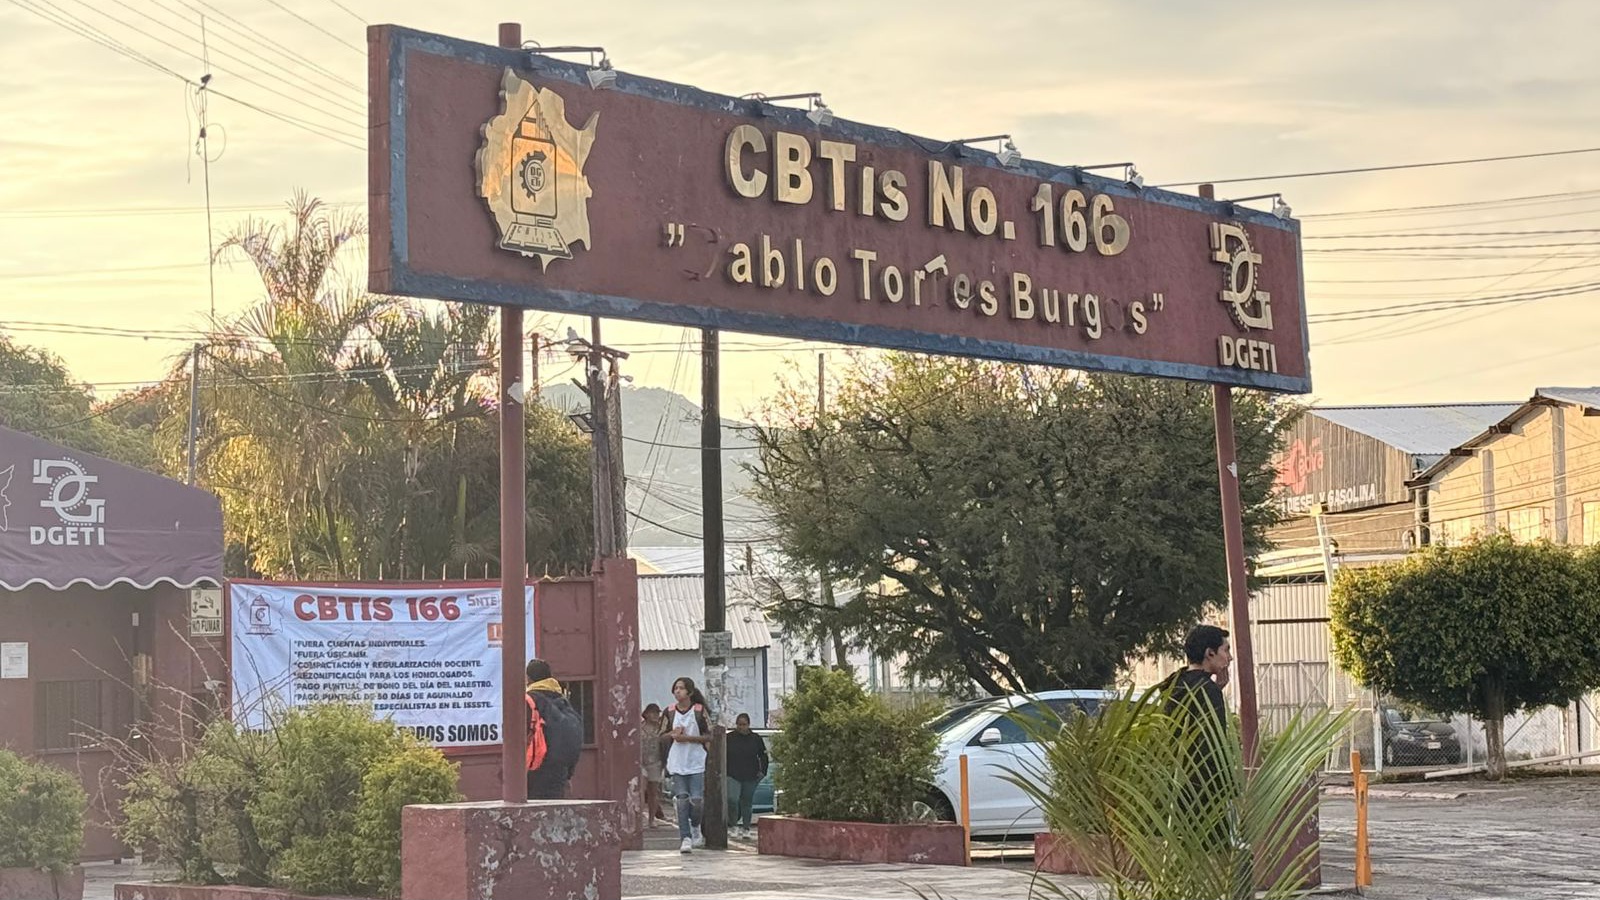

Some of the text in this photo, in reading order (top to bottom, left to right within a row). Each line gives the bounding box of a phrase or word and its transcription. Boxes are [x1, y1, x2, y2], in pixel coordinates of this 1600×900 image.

[724, 124, 1130, 257] CBTis No. 166
[1218, 335, 1278, 374] DGETI
[1328, 483, 1376, 507] GASOLINA
[30, 526, 105, 546] DGETI
[293, 594, 461, 621] CBTIS 166
[201, 619, 221, 633] FUMAR
[327, 640, 366, 648] CUENTAS
[372, 659, 442, 669] REGULARIZACIÓN
[393, 671, 410, 679] LOS
[363, 682, 376, 690] DE
[377, 682, 400, 690] BONO
[402, 682, 418, 690] DEL
[420, 680, 435, 689] DÍA
[437, 681, 452, 689] DEL
[390, 691, 411, 700] DÍAS
[413, 692, 425, 700] DE
[427, 691, 473, 699] AGUINALDO
[374, 702, 437, 711] ESPECIALISTAS
[448, 723, 499, 742] SOMOS
